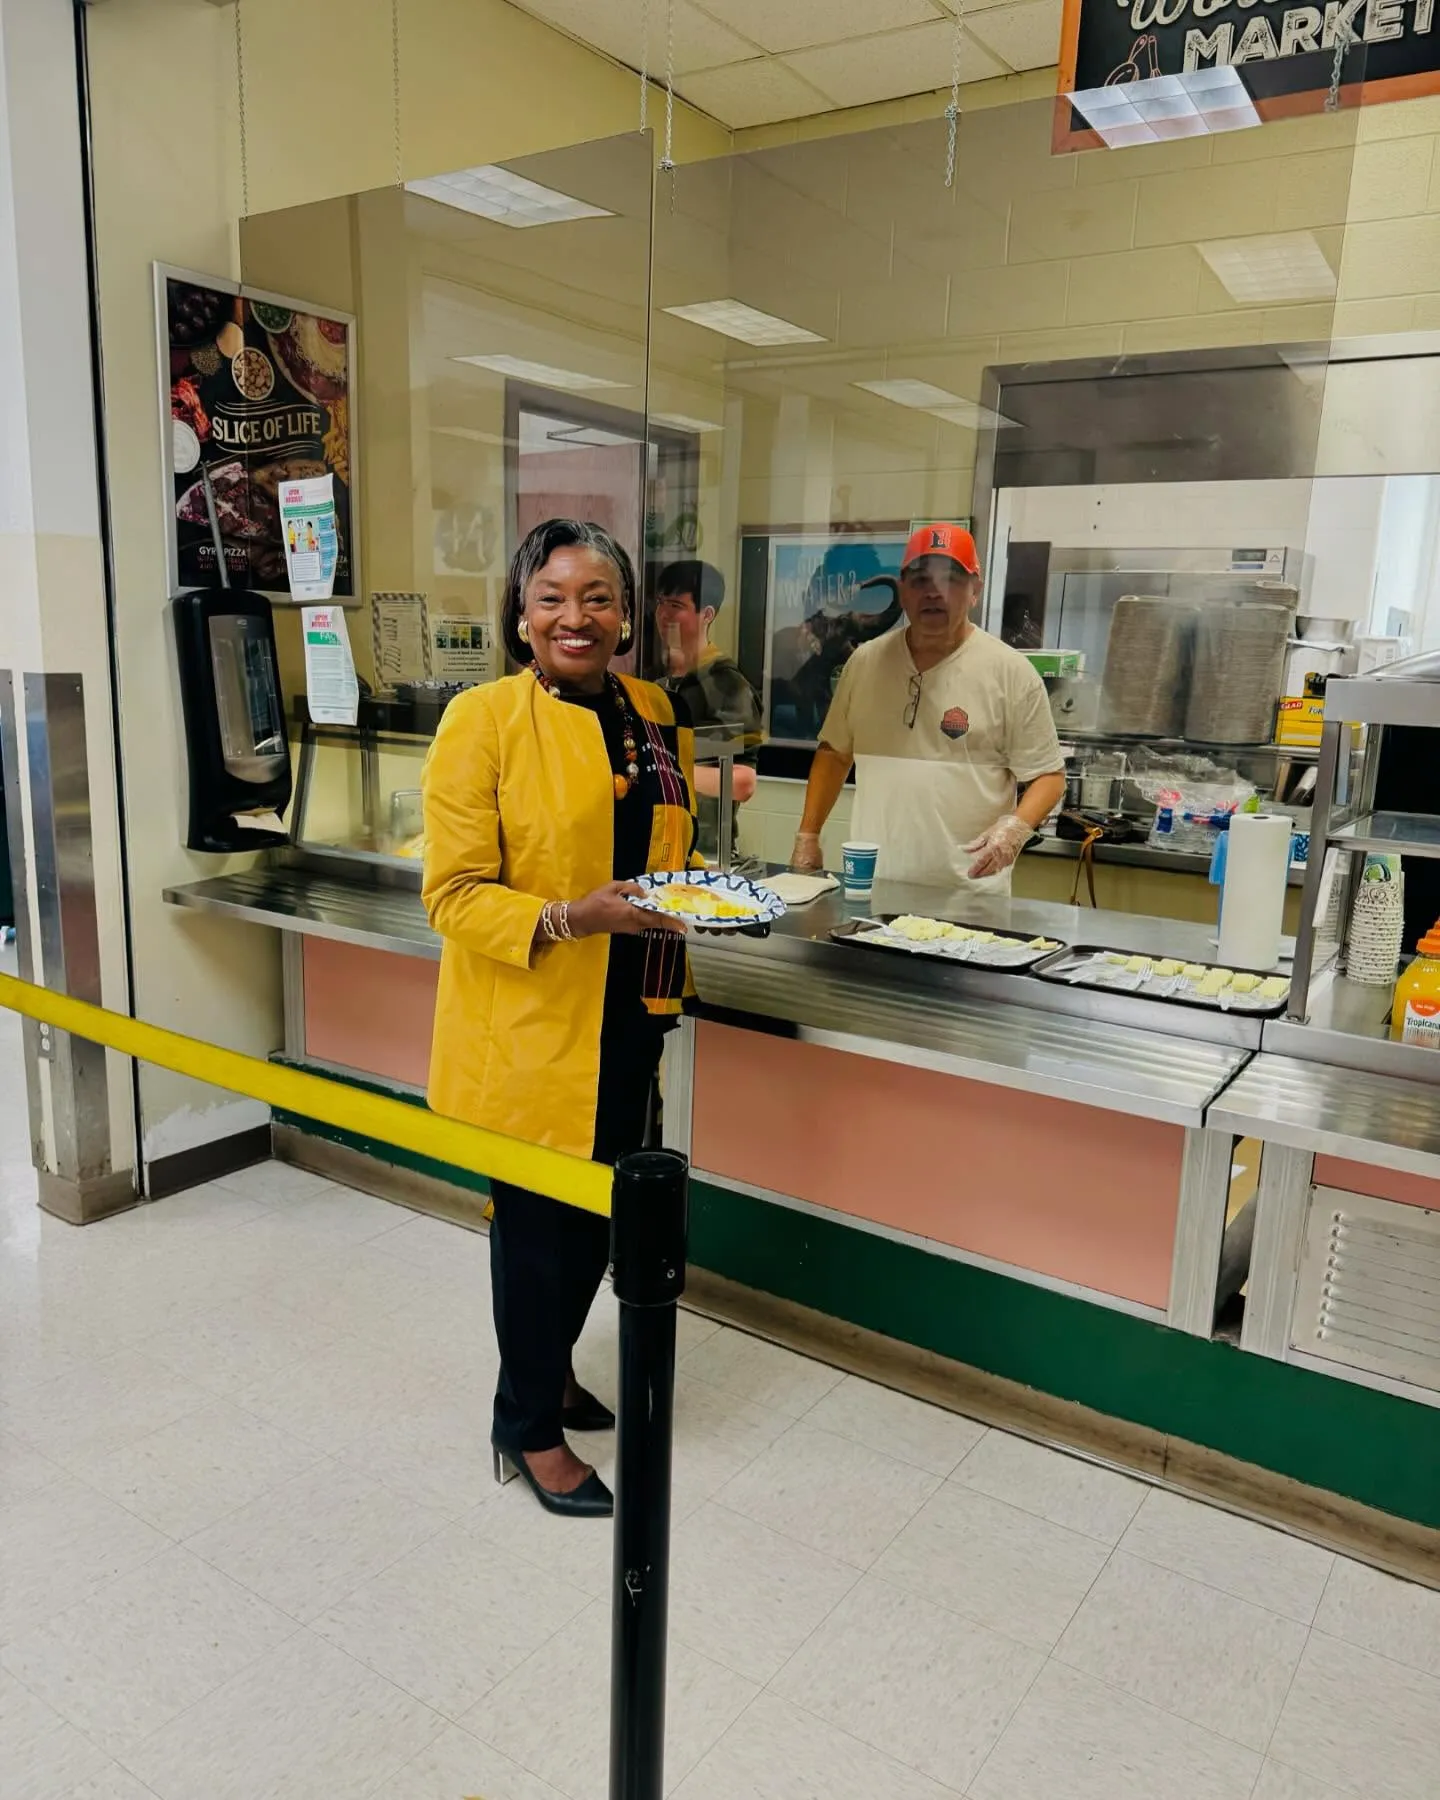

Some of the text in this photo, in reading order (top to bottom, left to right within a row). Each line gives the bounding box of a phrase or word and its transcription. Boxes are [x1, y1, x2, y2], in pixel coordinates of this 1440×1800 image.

[1183, 0, 1436, 73] MARKET
[211, 411, 322, 444] SLICE OF LIFE
[198, 545, 247, 557] GYR PIZZA
[783, 569, 857, 609] WATER?
[1280, 702, 1302, 710] GLAD
